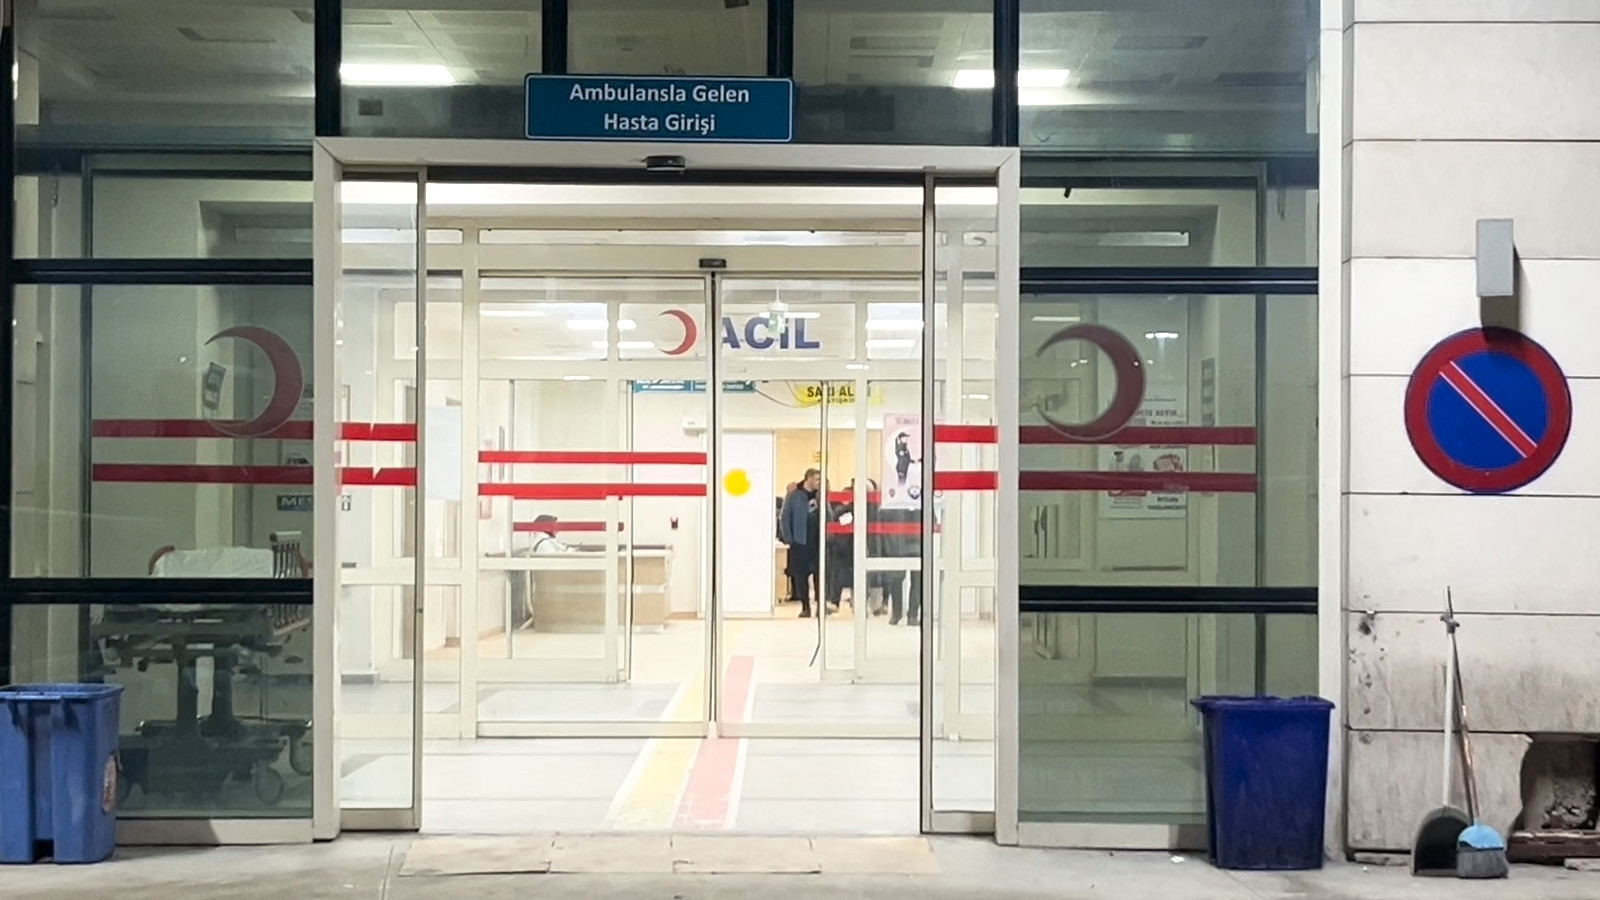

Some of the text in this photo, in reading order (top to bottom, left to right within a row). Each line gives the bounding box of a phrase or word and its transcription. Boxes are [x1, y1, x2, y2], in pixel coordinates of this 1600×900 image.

[569, 83, 750, 104] Ambulansla Gelen
[603, 113, 716, 135] Hasta Girişi
